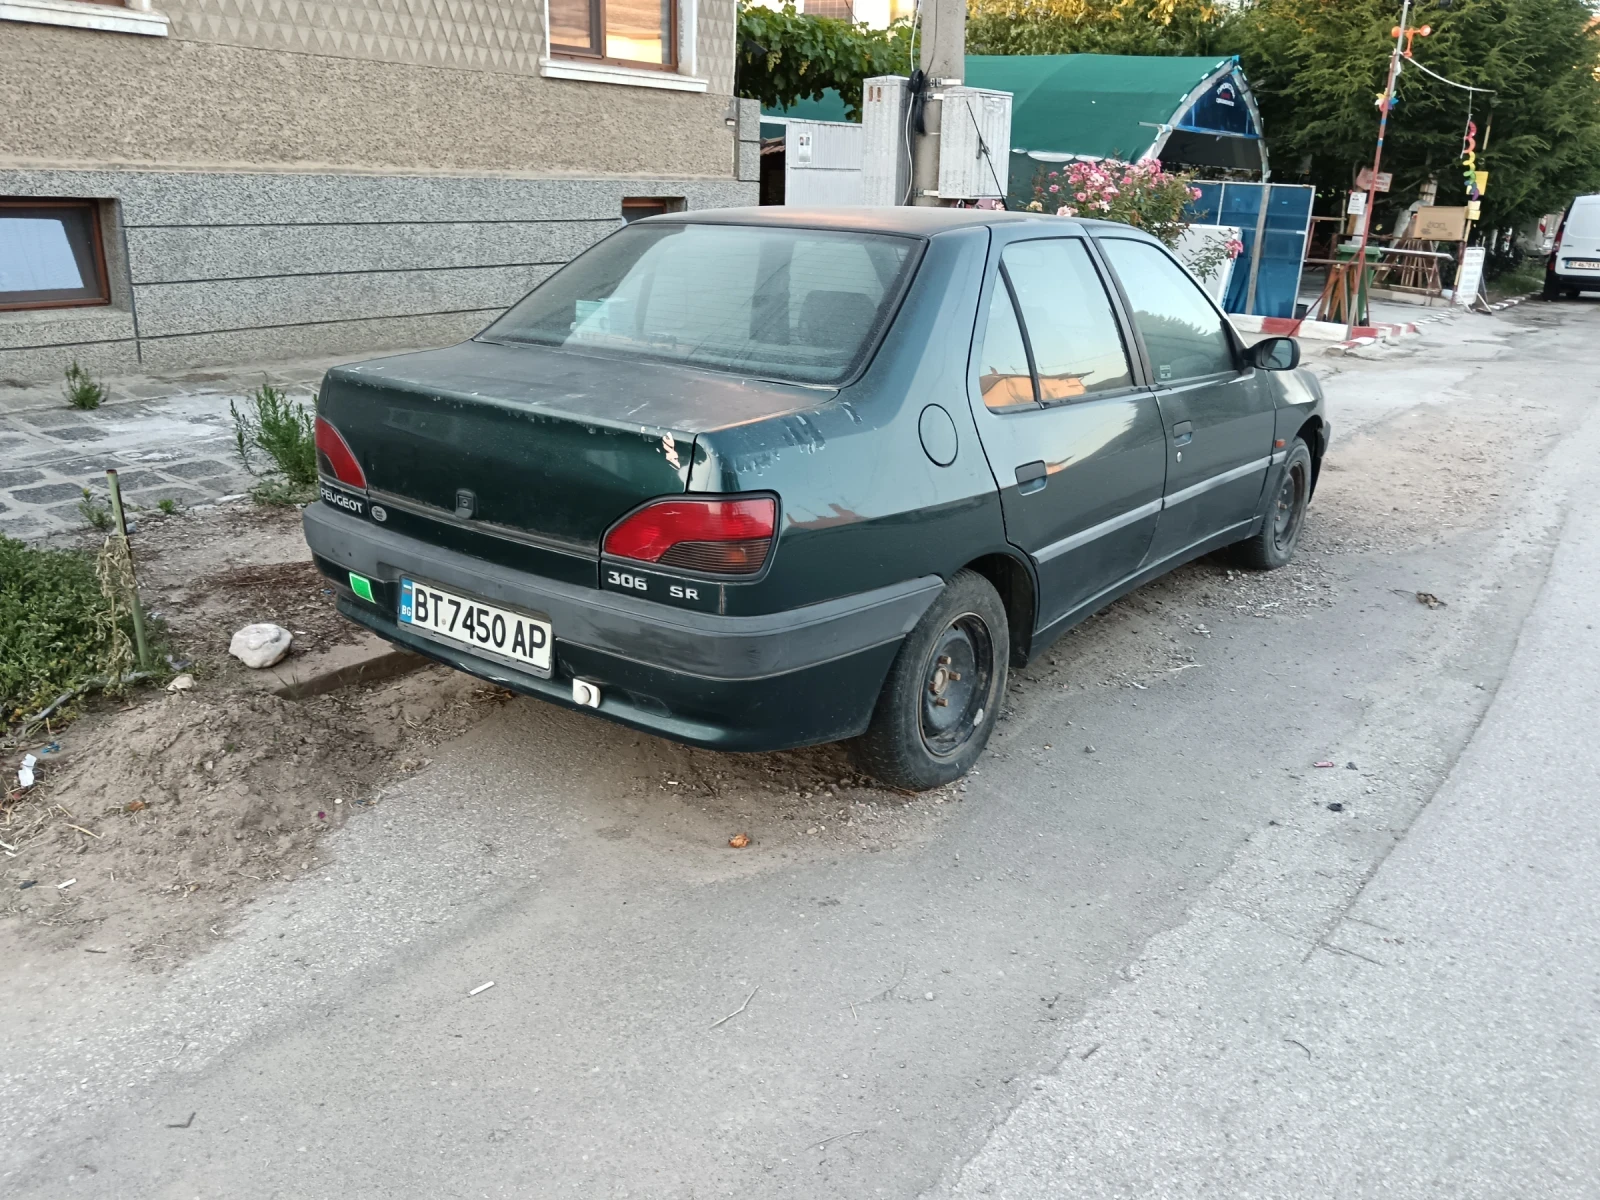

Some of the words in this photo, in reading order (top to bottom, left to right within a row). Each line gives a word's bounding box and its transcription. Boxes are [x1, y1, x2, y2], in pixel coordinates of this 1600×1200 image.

[320, 487, 363, 514] PEUGEOT
[607, 571, 648, 591] 306
[669, 585, 700, 600] SR
[401, 604, 412, 616] BG
[415, 587, 443, 628] BT
[447, 598, 507, 649] 7450
[511, 619, 547, 659] AP
